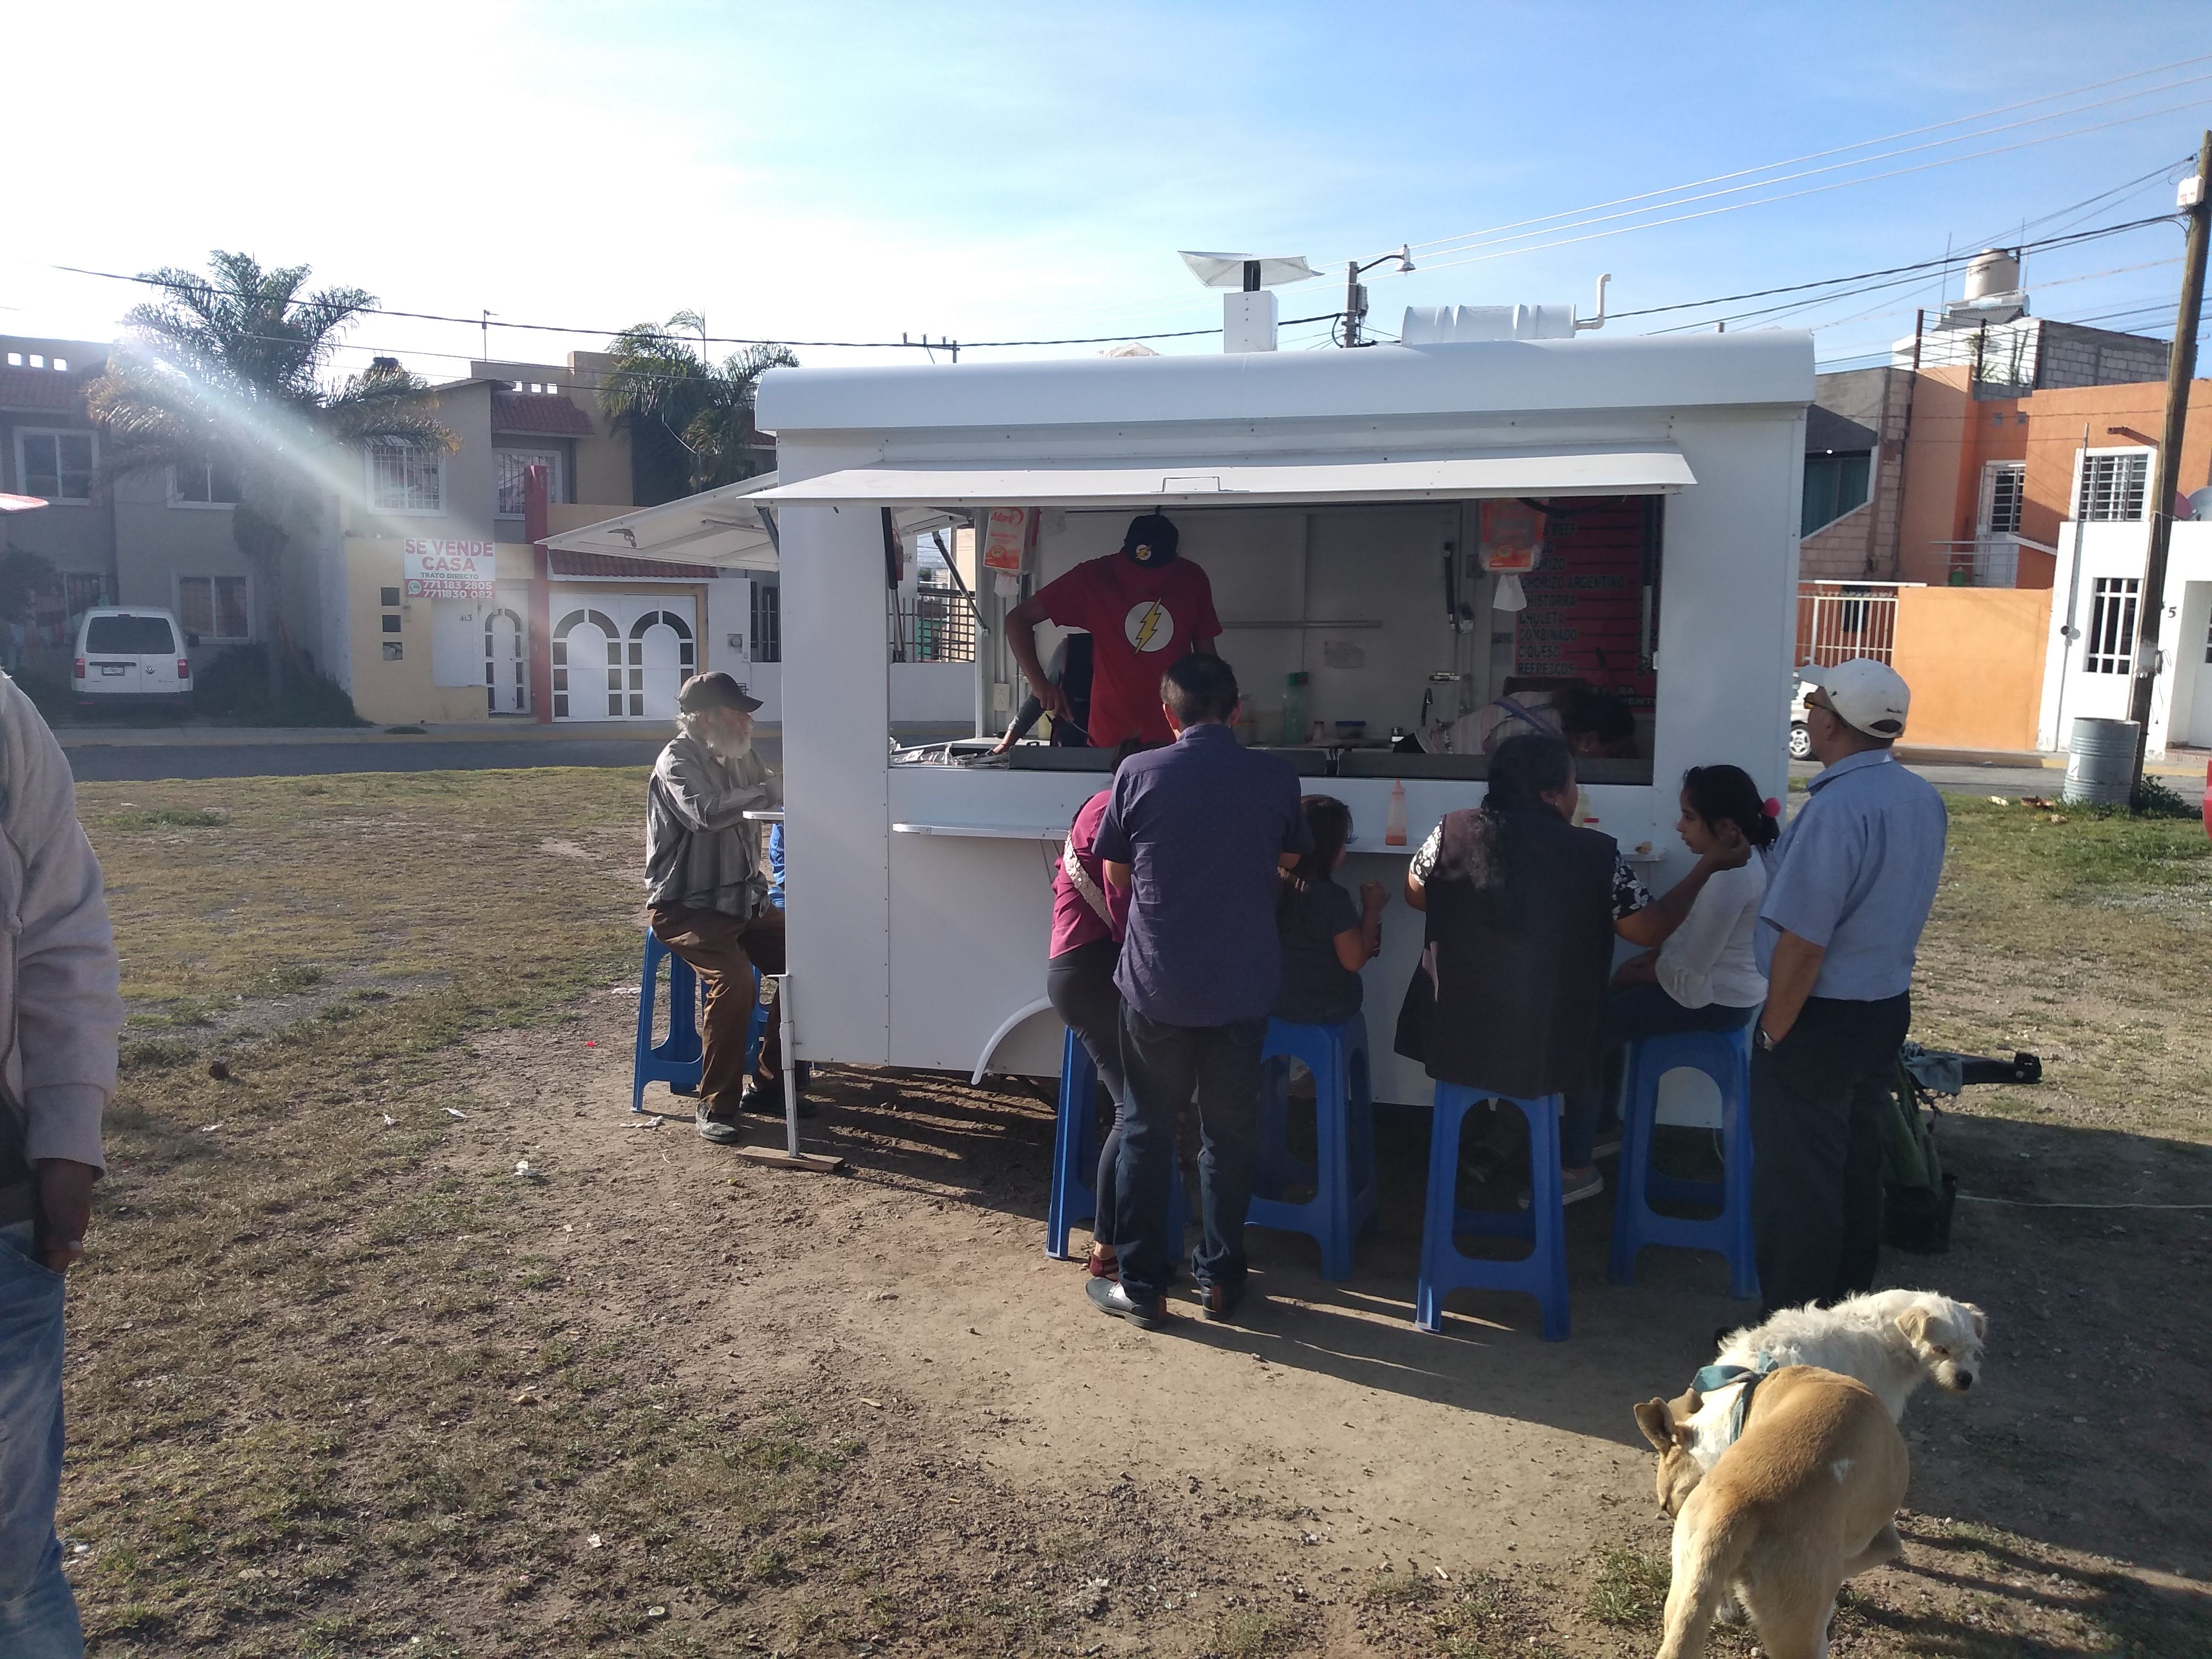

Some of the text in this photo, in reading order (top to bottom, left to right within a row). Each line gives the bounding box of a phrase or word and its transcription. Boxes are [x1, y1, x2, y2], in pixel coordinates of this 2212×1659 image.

[405, 539, 493, 557] SE VENDE
[422, 556, 476, 572] CASA
[423, 580, 492, 590] 771 183 2805
[1521, 576, 1564, 589] CHORIZO
[471, 590, 493, 599] 082
[1526, 594, 1576, 607] HISTORRA
[1519, 611, 1564, 625] CHULETA
[1519, 628, 1578, 641] COMBINADO
[1518, 662, 1574, 675] REFRESCOS
